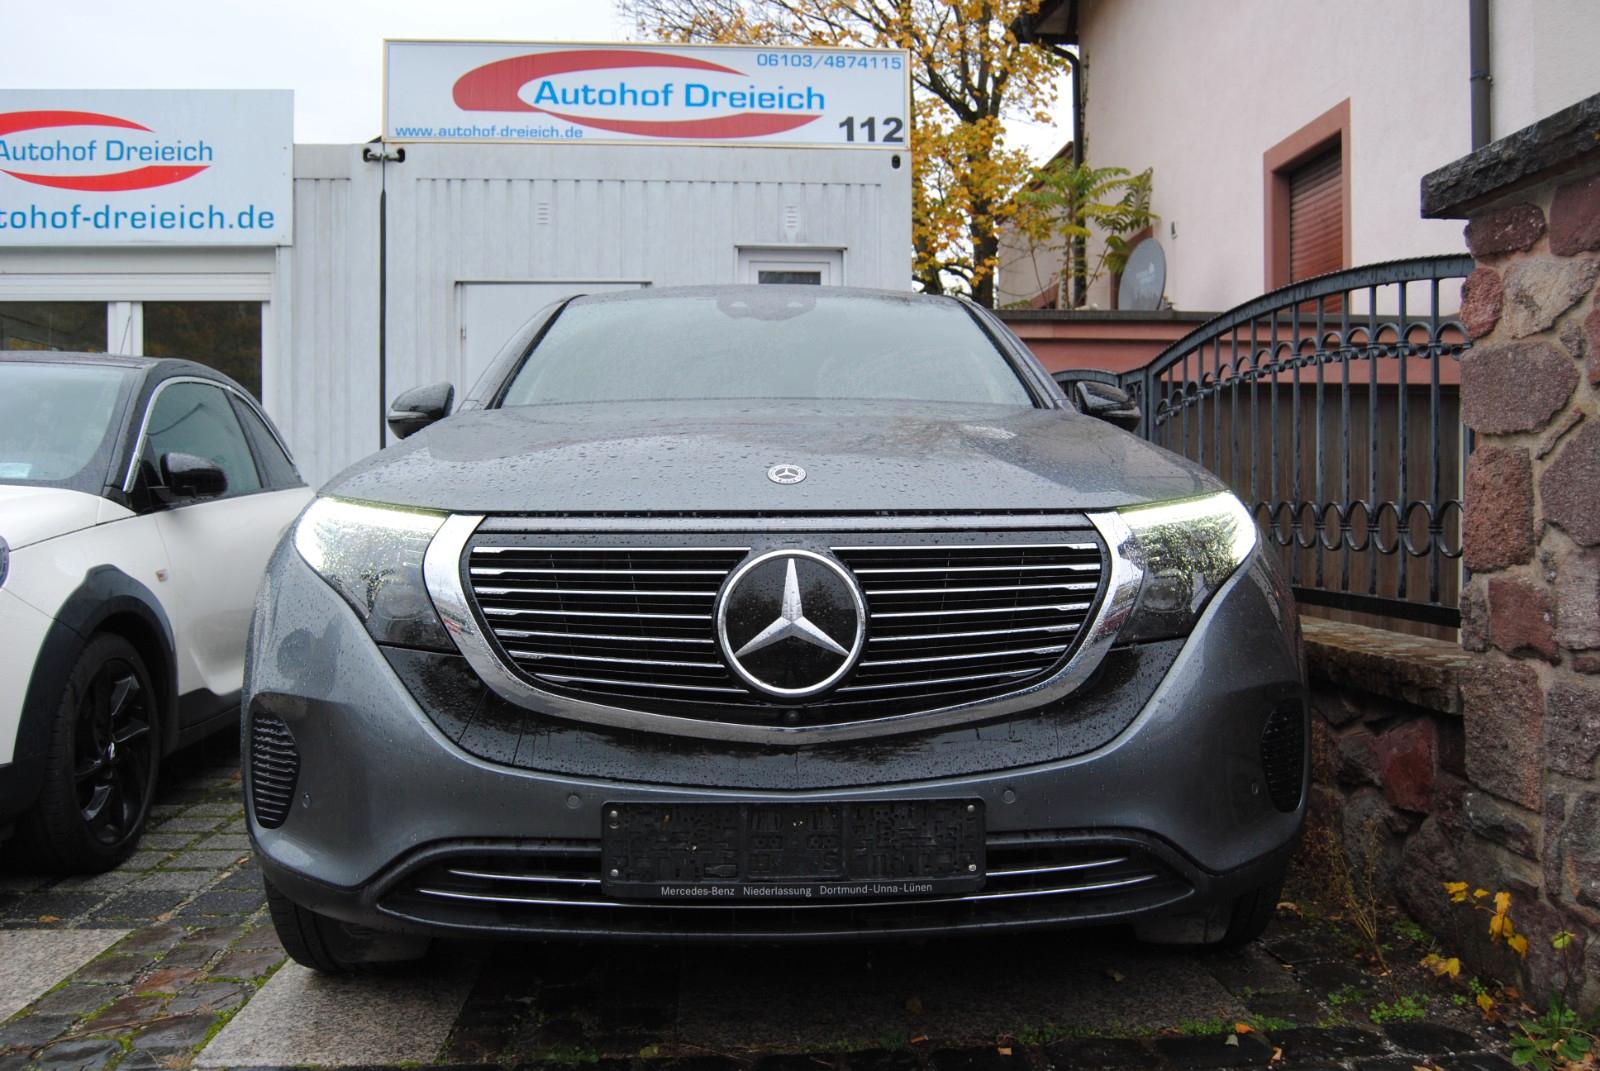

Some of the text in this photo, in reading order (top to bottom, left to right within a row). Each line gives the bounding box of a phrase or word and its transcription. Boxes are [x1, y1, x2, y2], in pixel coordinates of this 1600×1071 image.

[756, 53, 902, 70] 06103/4874115
[534, 80, 825, 110] Autohof Dreieich
[395, 124, 583, 139] www.autohof-dreieich.de
[838, 116, 904, 143] 112
[0, 140, 213, 161] Autohof Dreieich
[660, 883, 933, 897] Mercedes-Benz Niederlassung Dortmund-Unna-Lünen
